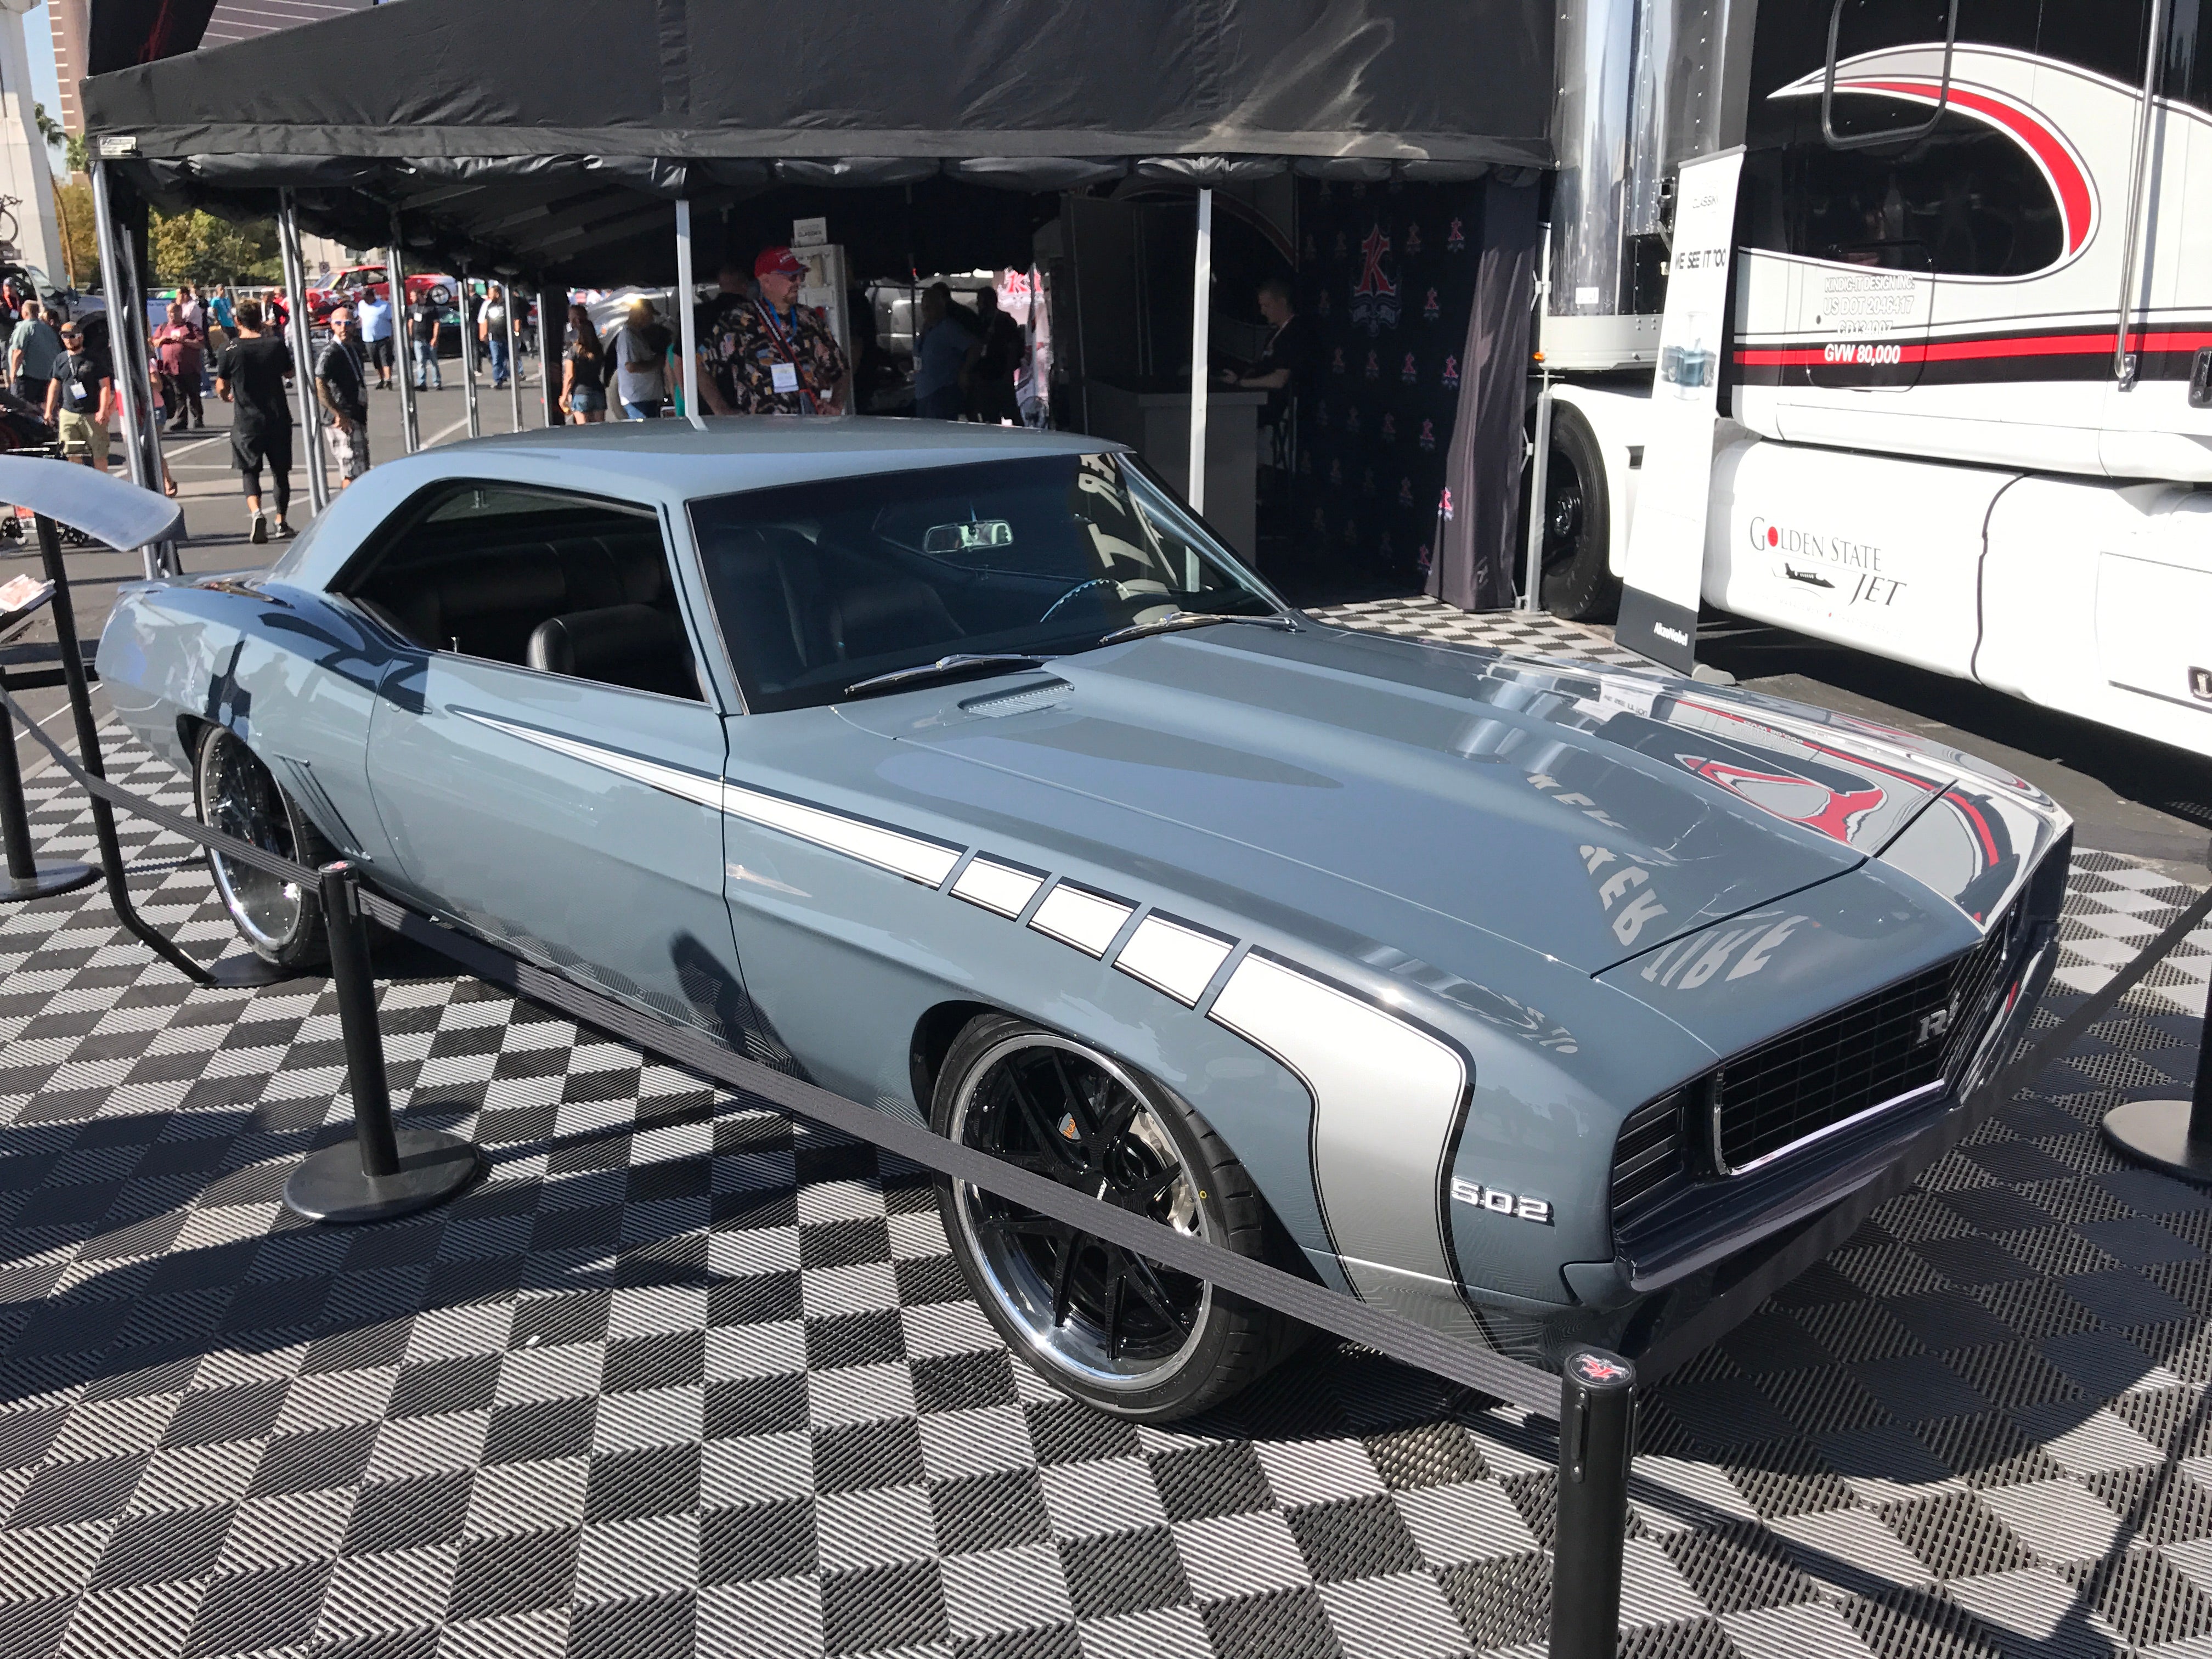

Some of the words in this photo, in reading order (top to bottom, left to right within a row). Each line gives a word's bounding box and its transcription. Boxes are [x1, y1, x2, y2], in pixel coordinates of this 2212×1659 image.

[1688, 251, 1701, 269] SEE
[1703, 250, 1712, 268] IT
[1825, 276, 1863, 293] KINDIG-IT
[1864, 275, 1896, 292] DESIGN
[1897, 274, 1915, 290] INC.
[1824, 297, 1839, 315] US
[1841, 296, 1865, 315] DOT
[1866, 295, 1914, 315] 2046417
[1824, 343, 1855, 362] GVW
[1857, 345, 1901, 367] 80,000
[1750, 517, 1824, 558] GOLDEN
[1831, 538, 1881, 572] STATE
[1848, 573, 1907, 606] JET
[1451, 1176, 1554, 1222] 502
